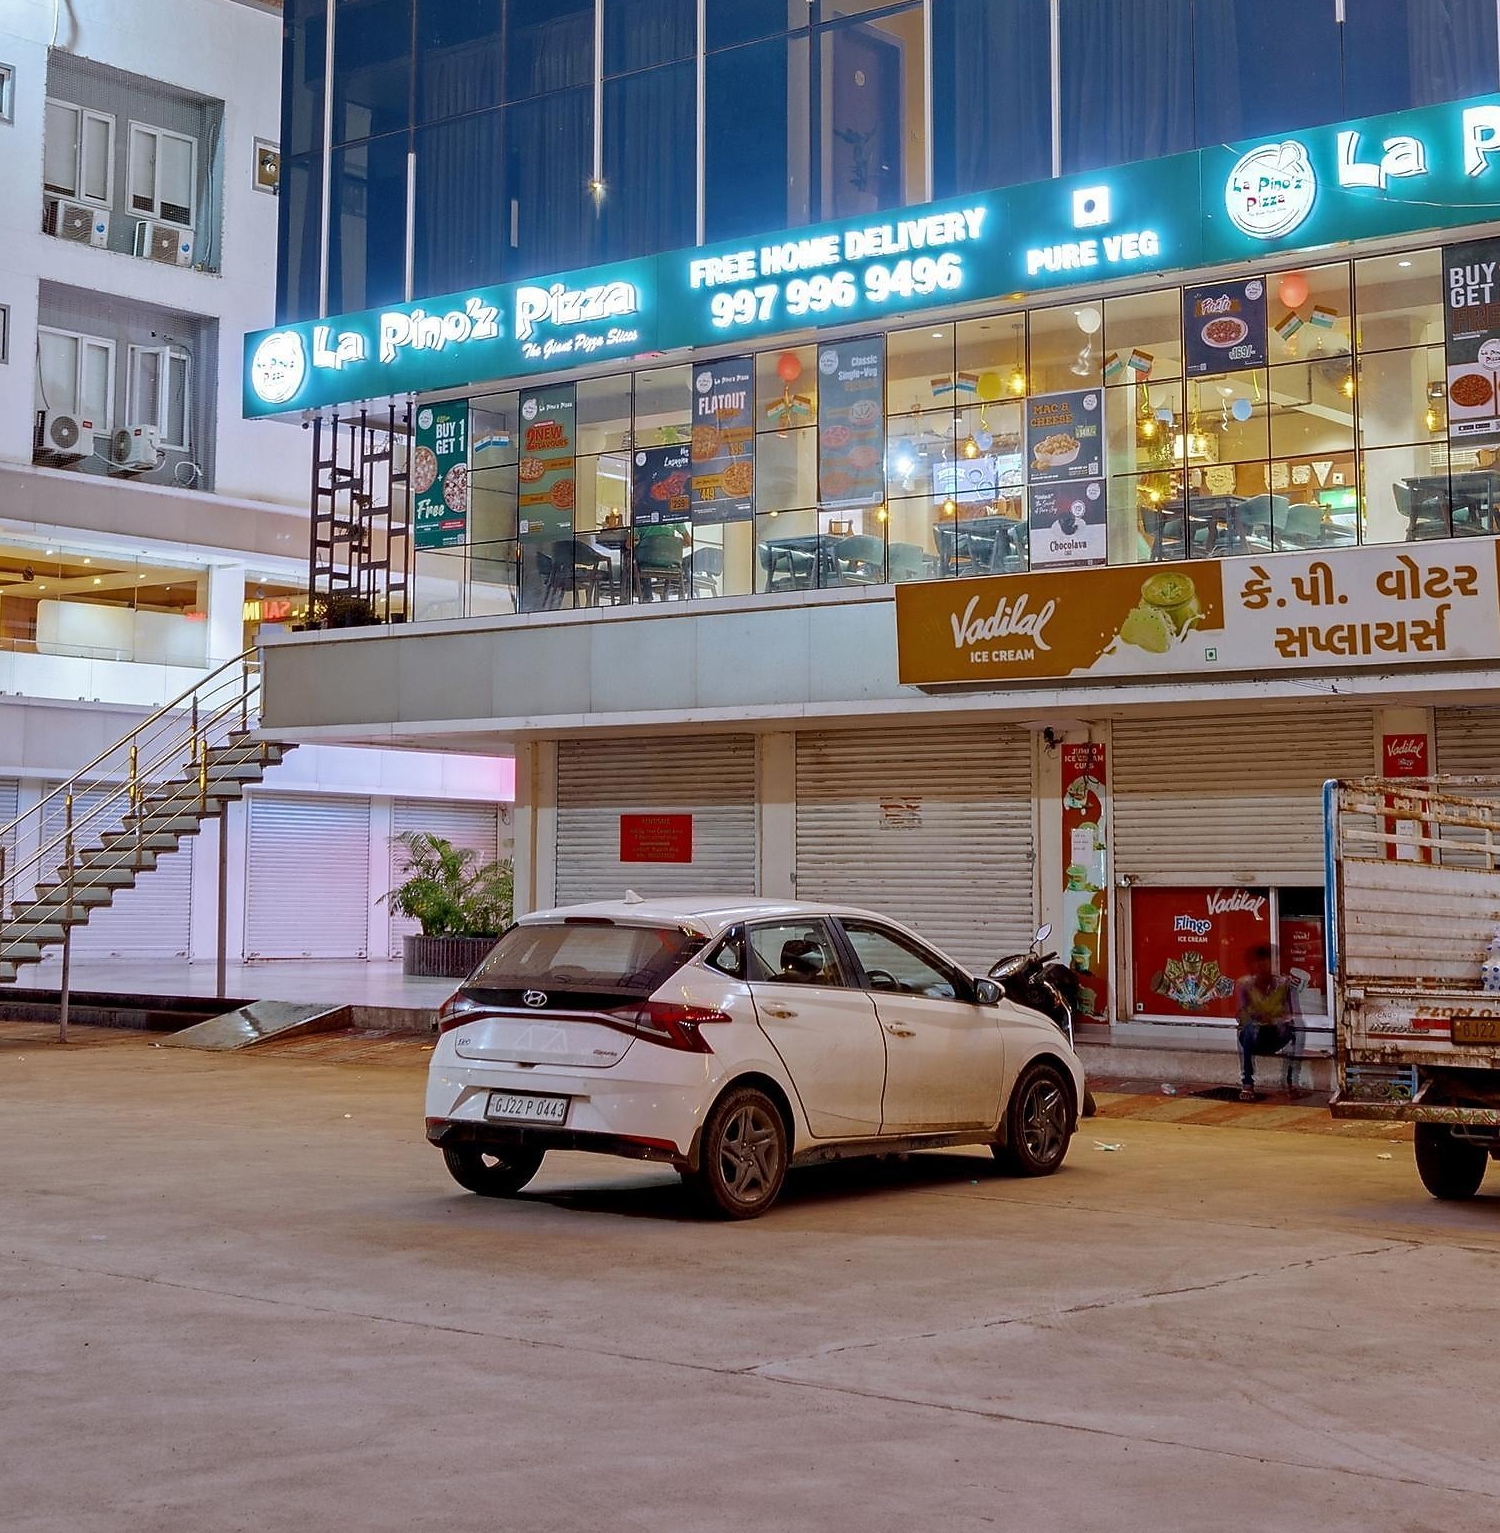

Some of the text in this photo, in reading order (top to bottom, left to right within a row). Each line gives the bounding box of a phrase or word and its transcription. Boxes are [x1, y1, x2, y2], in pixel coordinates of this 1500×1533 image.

[1335, 131, 1428, 190] La
[1233, 177, 1250, 192] La
[1247, 194, 1285, 212] Pizza
[689, 207, 987, 290] FREE HOME DELIVERY
[1026, 230, 1161, 276] PURE VEG
[1449, 261, 1497, 288] BUY
[711, 252, 964, 329] 997 996 9496
[1450, 283, 1495, 308] GET
[1201, 293, 1232, 316] Pasta
[313, 325, 366, 370] La
[379, 297, 501, 363] Pino'z
[515, 281, 639, 340] Pizza
[521, 327, 639, 360] The Giant Pizza Slices
[851, 354, 879, 367] Classic
[698, 390, 747, 416] FLATOUT
[436, 421, 457, 439] BUY
[459, 418, 465, 436] 1
[436, 435, 465, 455] GET 1
[416, 498, 445, 520] Free
[1049, 539, 1088, 552] Chocolava
[1375, 555, 1479, 600] વોટર
[950, 594, 1058, 652] Vadilal
[970, 647, 1036, 663] ICE CREAM
[1387, 738, 1424, 759] Vadilal
[1206, 887, 1266, 921] Vadilal
[1173, 914, 1213, 936] Flingo
[1177, 935, 1209, 944] ICE CREAM
[1461, 1022, 1497, 1039] GJ22
[495, 1097, 565, 1118] GJ22 P 0443
